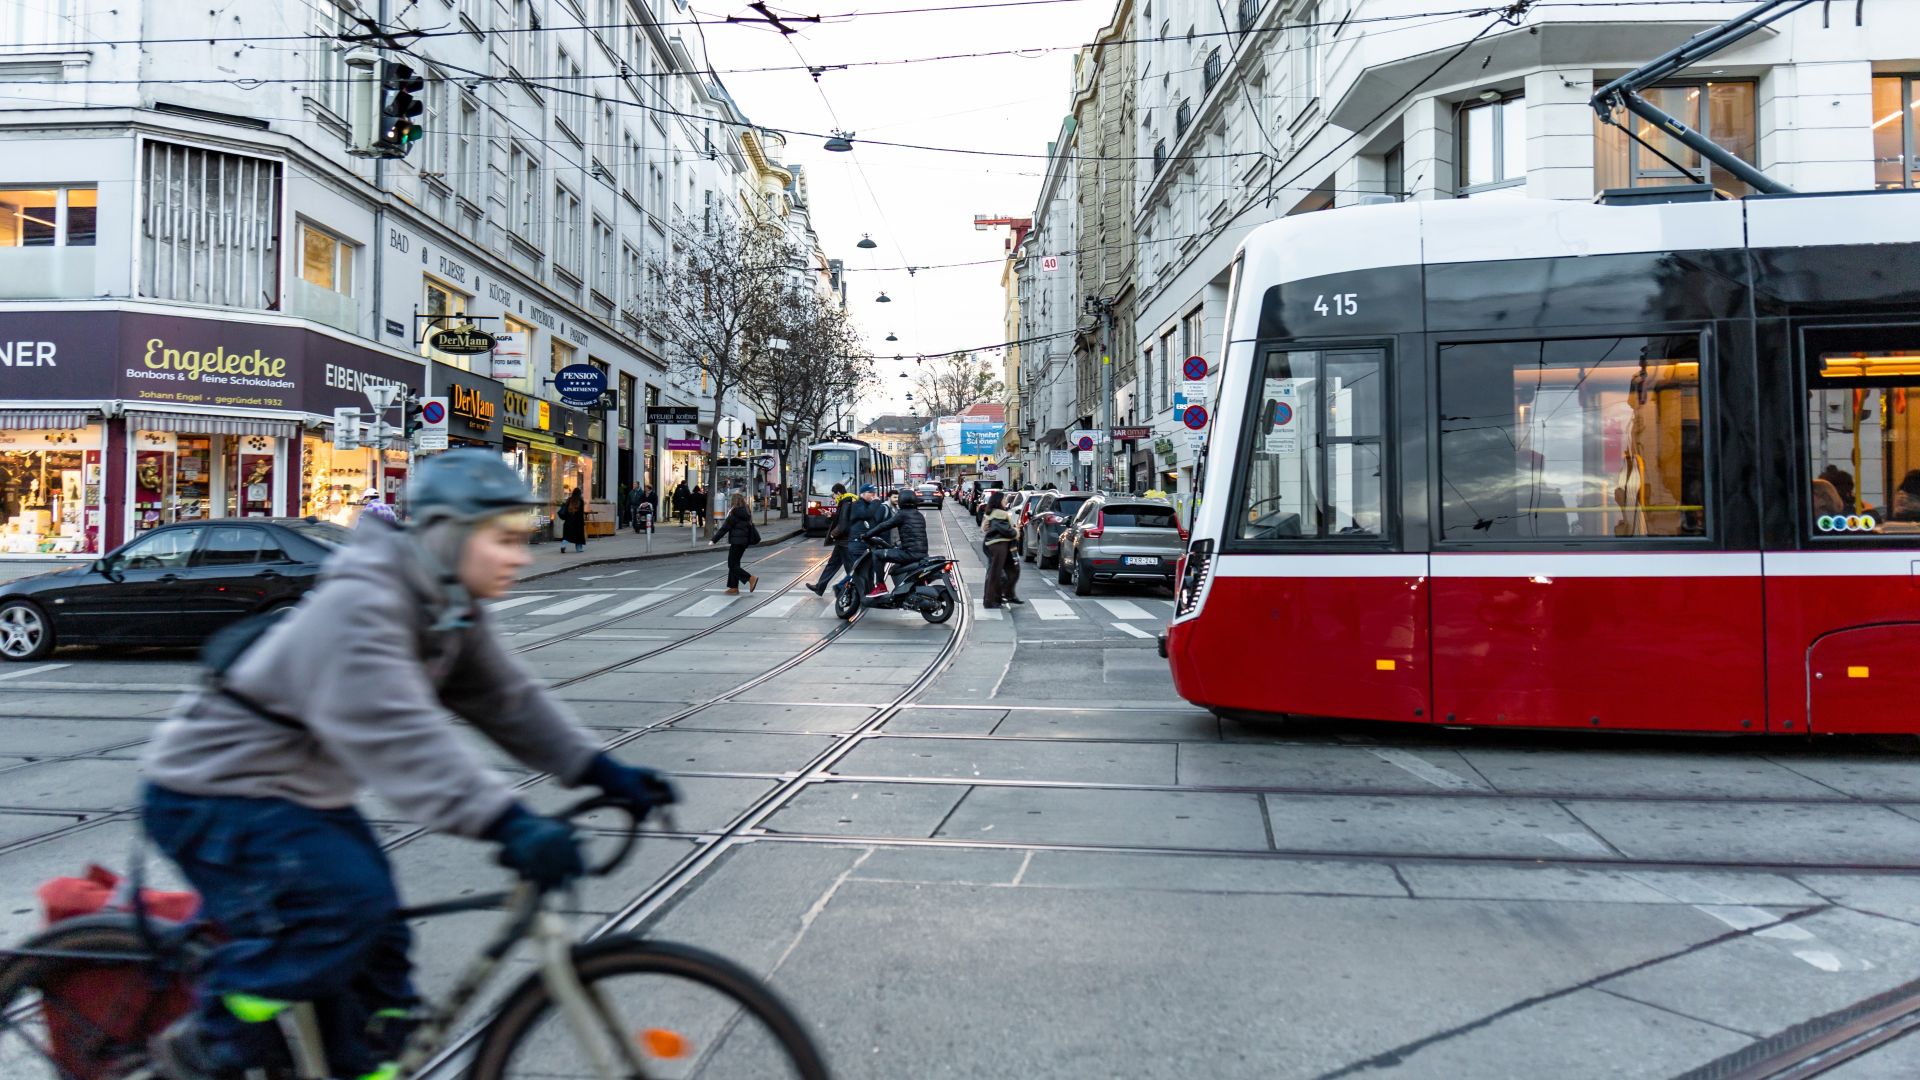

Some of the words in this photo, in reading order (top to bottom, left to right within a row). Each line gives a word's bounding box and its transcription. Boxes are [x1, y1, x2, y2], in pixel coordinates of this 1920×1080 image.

[390, 228, 409, 253] BAD
[440, 255, 465, 283] FLIESE
[1044, 258, 1056, 268] 40
[1313, 293, 1358, 316] 415
[439, 333, 488, 347] DerMann
[144, 338, 286, 381] Engelecke
[126, 369, 176, 381] Bonbons
[177, 372, 185, 381] &
[201, 374, 228, 385] feine
[229, 376, 295, 389] Schokoladen
[563, 372, 598, 380] PENSION
[139, 390, 174, 400] Johann
[176, 392, 202, 402] Engel
[215, 396, 262, 406] gegründet
[263, 398, 283, 407] 1932
[454, 384, 495, 418] DerMann
[503, 391, 529, 416] OTO
